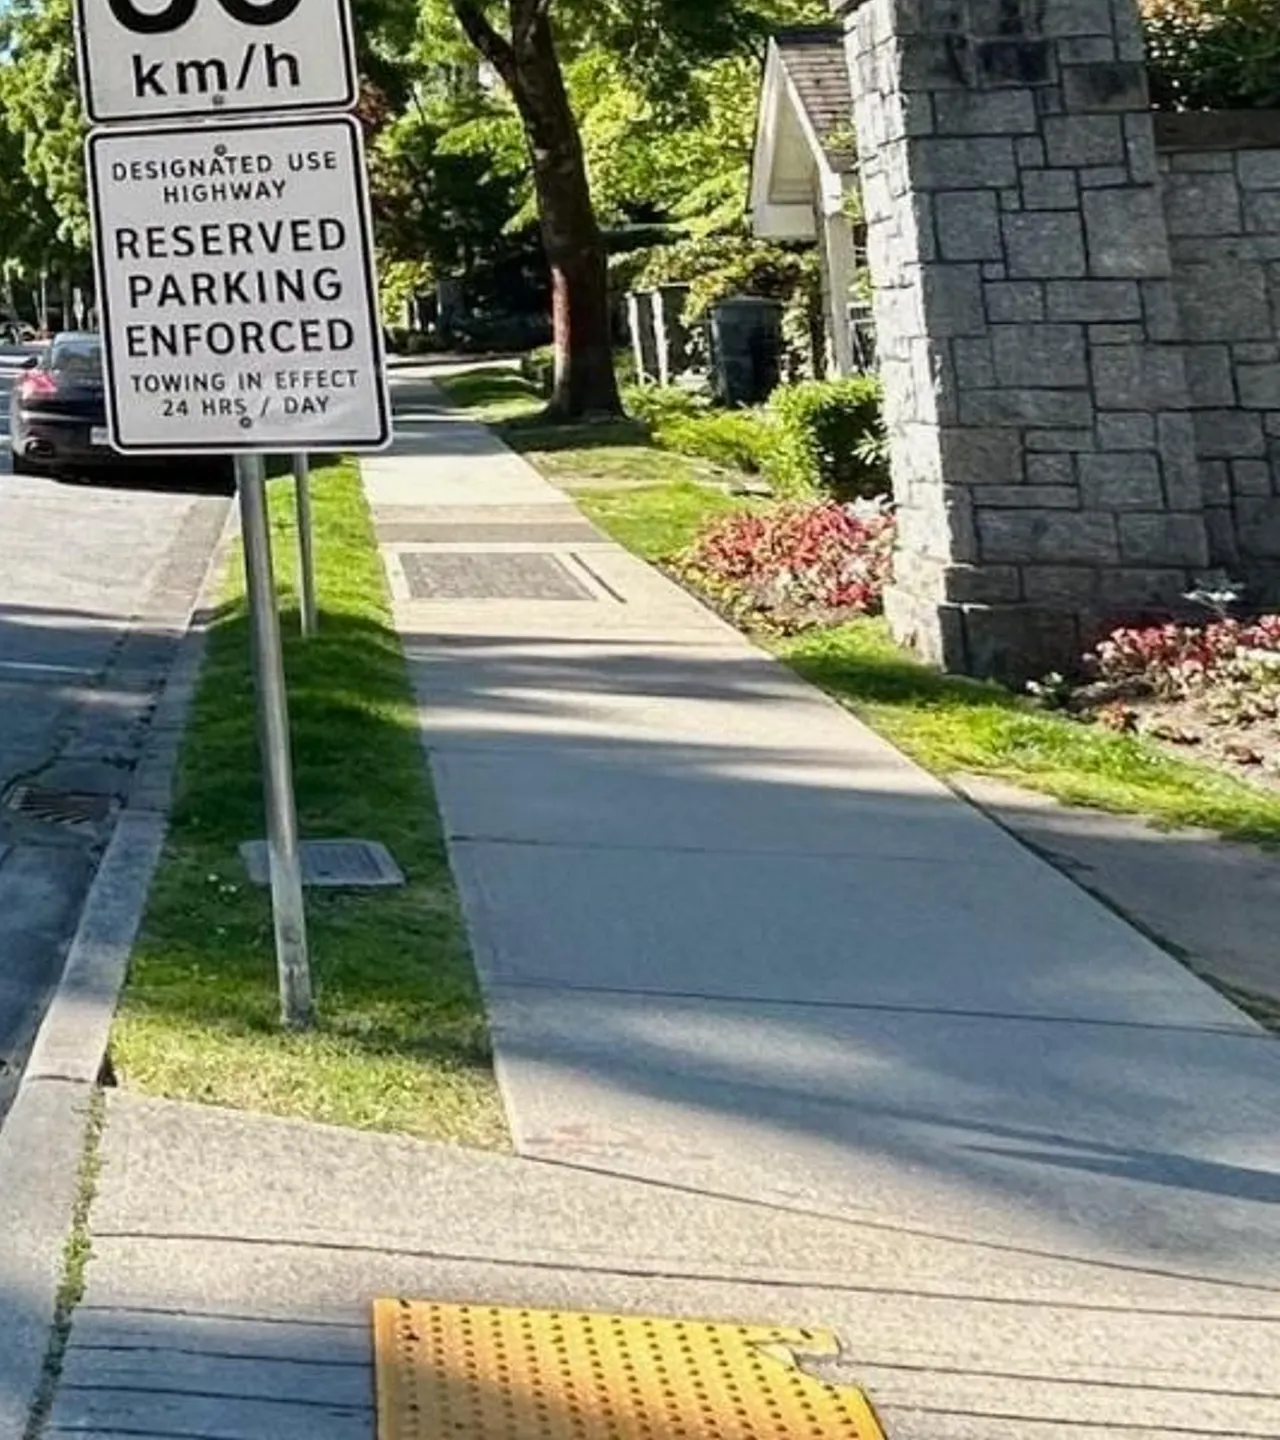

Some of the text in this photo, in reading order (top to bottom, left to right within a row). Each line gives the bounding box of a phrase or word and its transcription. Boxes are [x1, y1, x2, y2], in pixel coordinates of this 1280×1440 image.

[132, 41, 301, 98] km/h
[113, 152, 336, 181] DESIGNATED USE
[164, 181, 286, 203] HIGHWAY
[116, 218, 345, 260] RESERVED
[129, 268, 342, 308] PARKING
[126, 319, 354, 357] ENFORCED
[131, 369, 358, 393] TOWING IN EFFECT
[164, 400, 188, 416] 24
[202, 399, 246, 415] HRS
[285, 396, 328, 413] DAY
